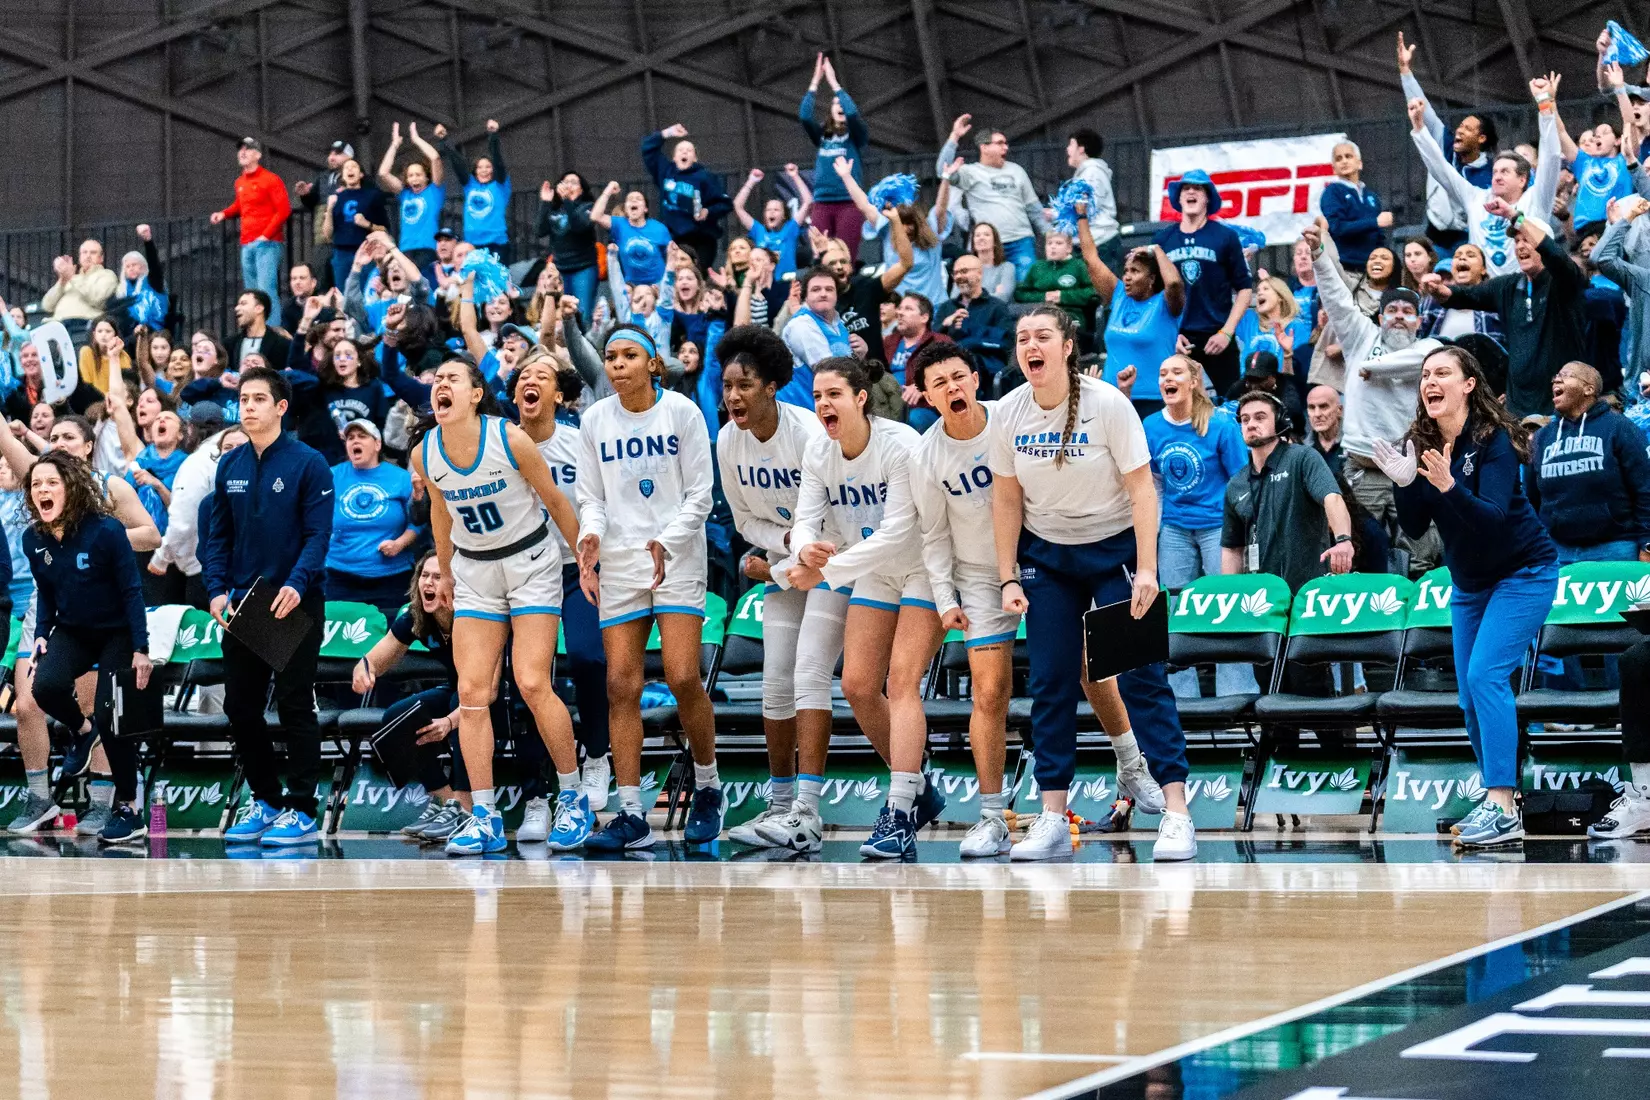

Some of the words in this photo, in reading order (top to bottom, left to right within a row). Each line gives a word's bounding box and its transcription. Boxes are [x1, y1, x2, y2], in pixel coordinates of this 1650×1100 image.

[1166, 246, 1217, 262] OLUMBIA
[600, 434, 680, 463] LIONS
[1015, 431, 1089, 446] COLUMIA
[737, 464, 801, 489] LIONS
[942, 465, 993, 496] LIO
[1541, 456, 1605, 479] UNIVERSITY
[442, 478, 508, 501] OLUMBIA
[826, 481, 888, 508] LIONS
[456, 501, 505, 535] 20
[76, 552, 90, 570] C
[1174, 587, 1240, 624] Ivy
[1301, 587, 1368, 625] Ivy
[1414, 579, 1452, 612] Iv
[1552, 575, 1623, 615] Ivy
[820, 778, 855, 804] vy
[1267, 764, 1330, 797] Ivy
[1393, 771, 1455, 810] Ivy
[352, 780, 405, 812] Ivy
